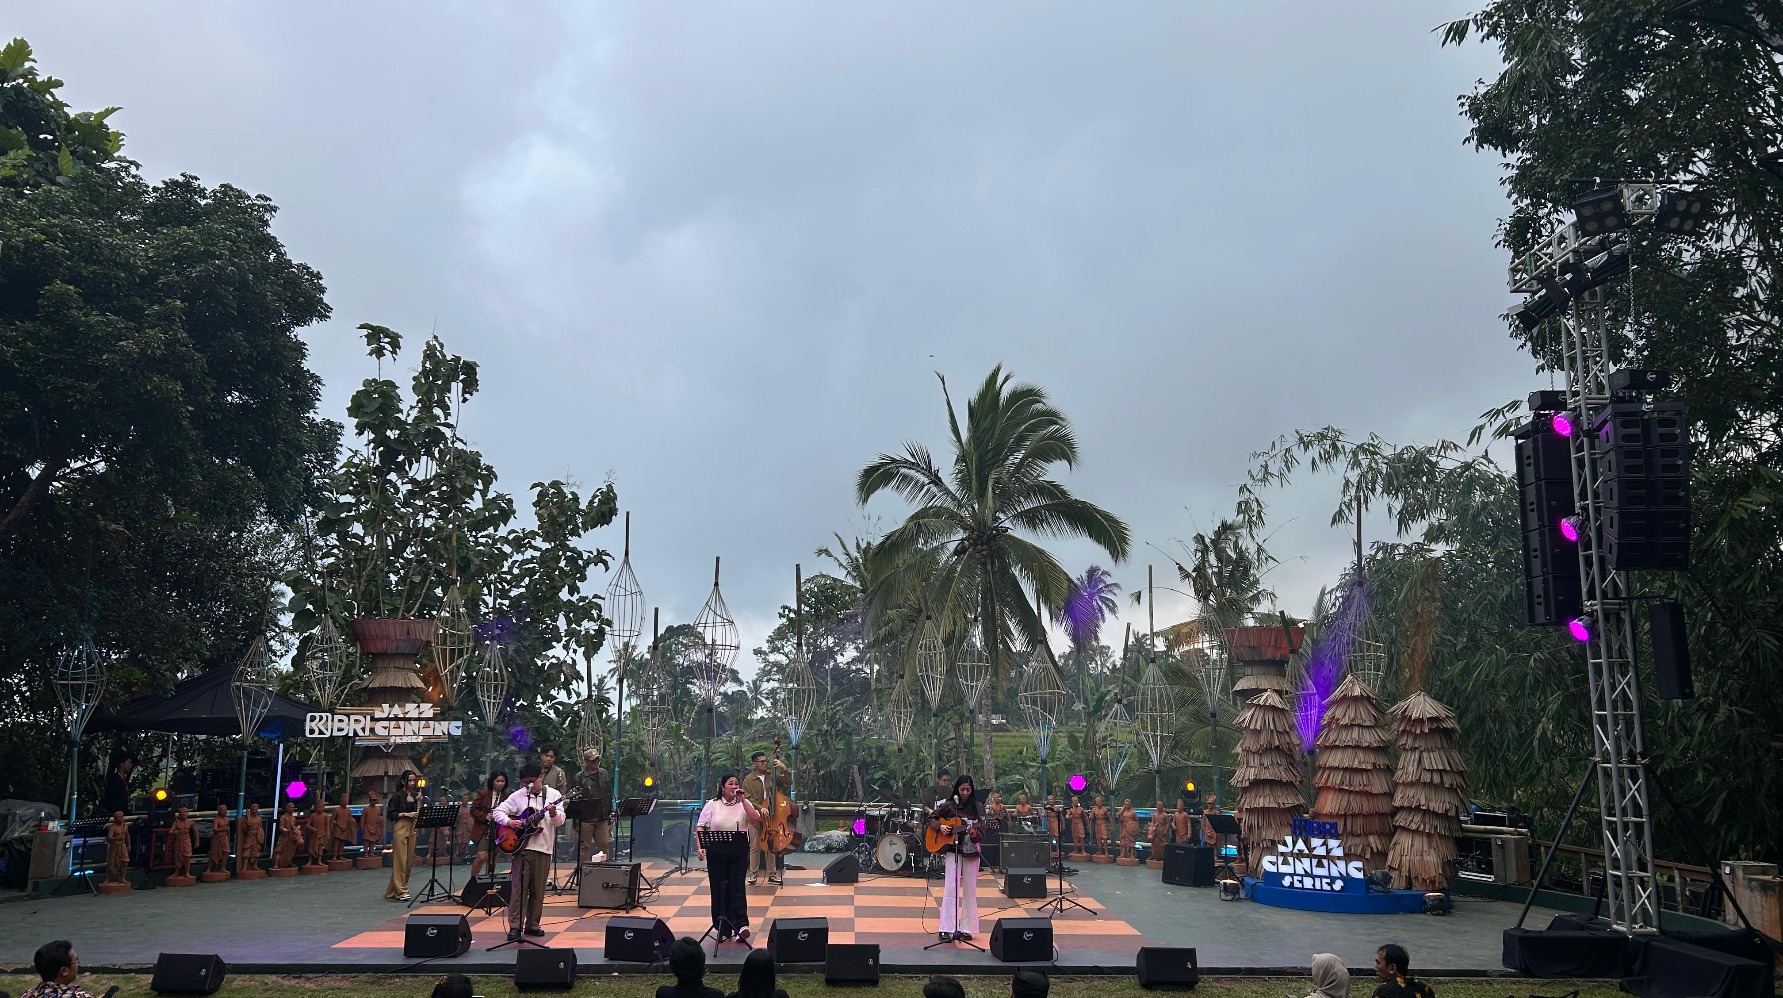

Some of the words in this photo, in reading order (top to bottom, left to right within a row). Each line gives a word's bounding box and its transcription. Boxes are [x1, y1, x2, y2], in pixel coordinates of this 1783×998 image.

[375, 704, 433, 717] JAZZ
[333, 715, 370, 736] BRI
[375, 721, 462, 735] GUNUNG
[1310, 821, 1338, 837] BRI
[1278, 836, 1343, 856] JAZZ
[1262, 855, 1364, 878] GUNUNG
[1282, 876, 1344, 890] SERIES
